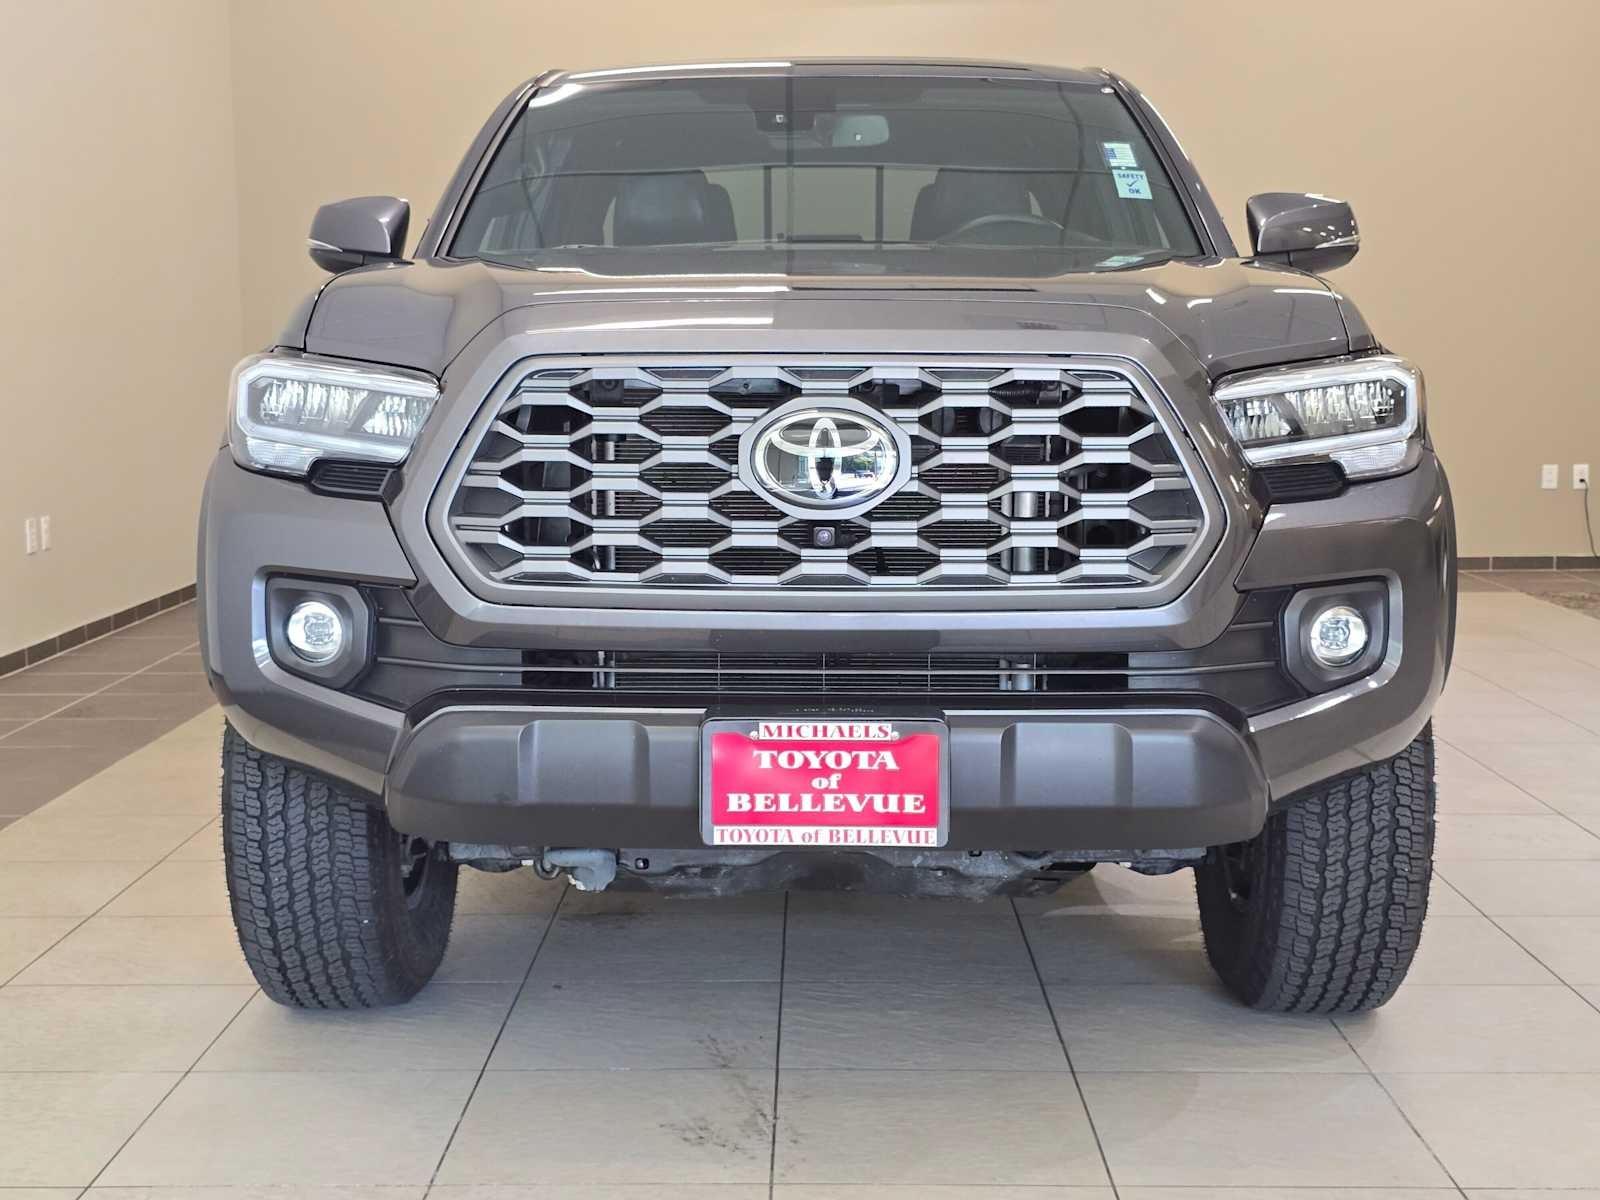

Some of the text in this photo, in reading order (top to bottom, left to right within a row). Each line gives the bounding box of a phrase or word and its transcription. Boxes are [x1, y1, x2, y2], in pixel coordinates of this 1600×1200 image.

[762, 724, 890, 739] MICHAELS
[753, 750, 899, 770] TOYOTA
[811, 774, 842, 790] of
[726, 793, 926, 814] BELLEVUE
[716, 828, 936, 845] TOYOTA of BELLEVUE
